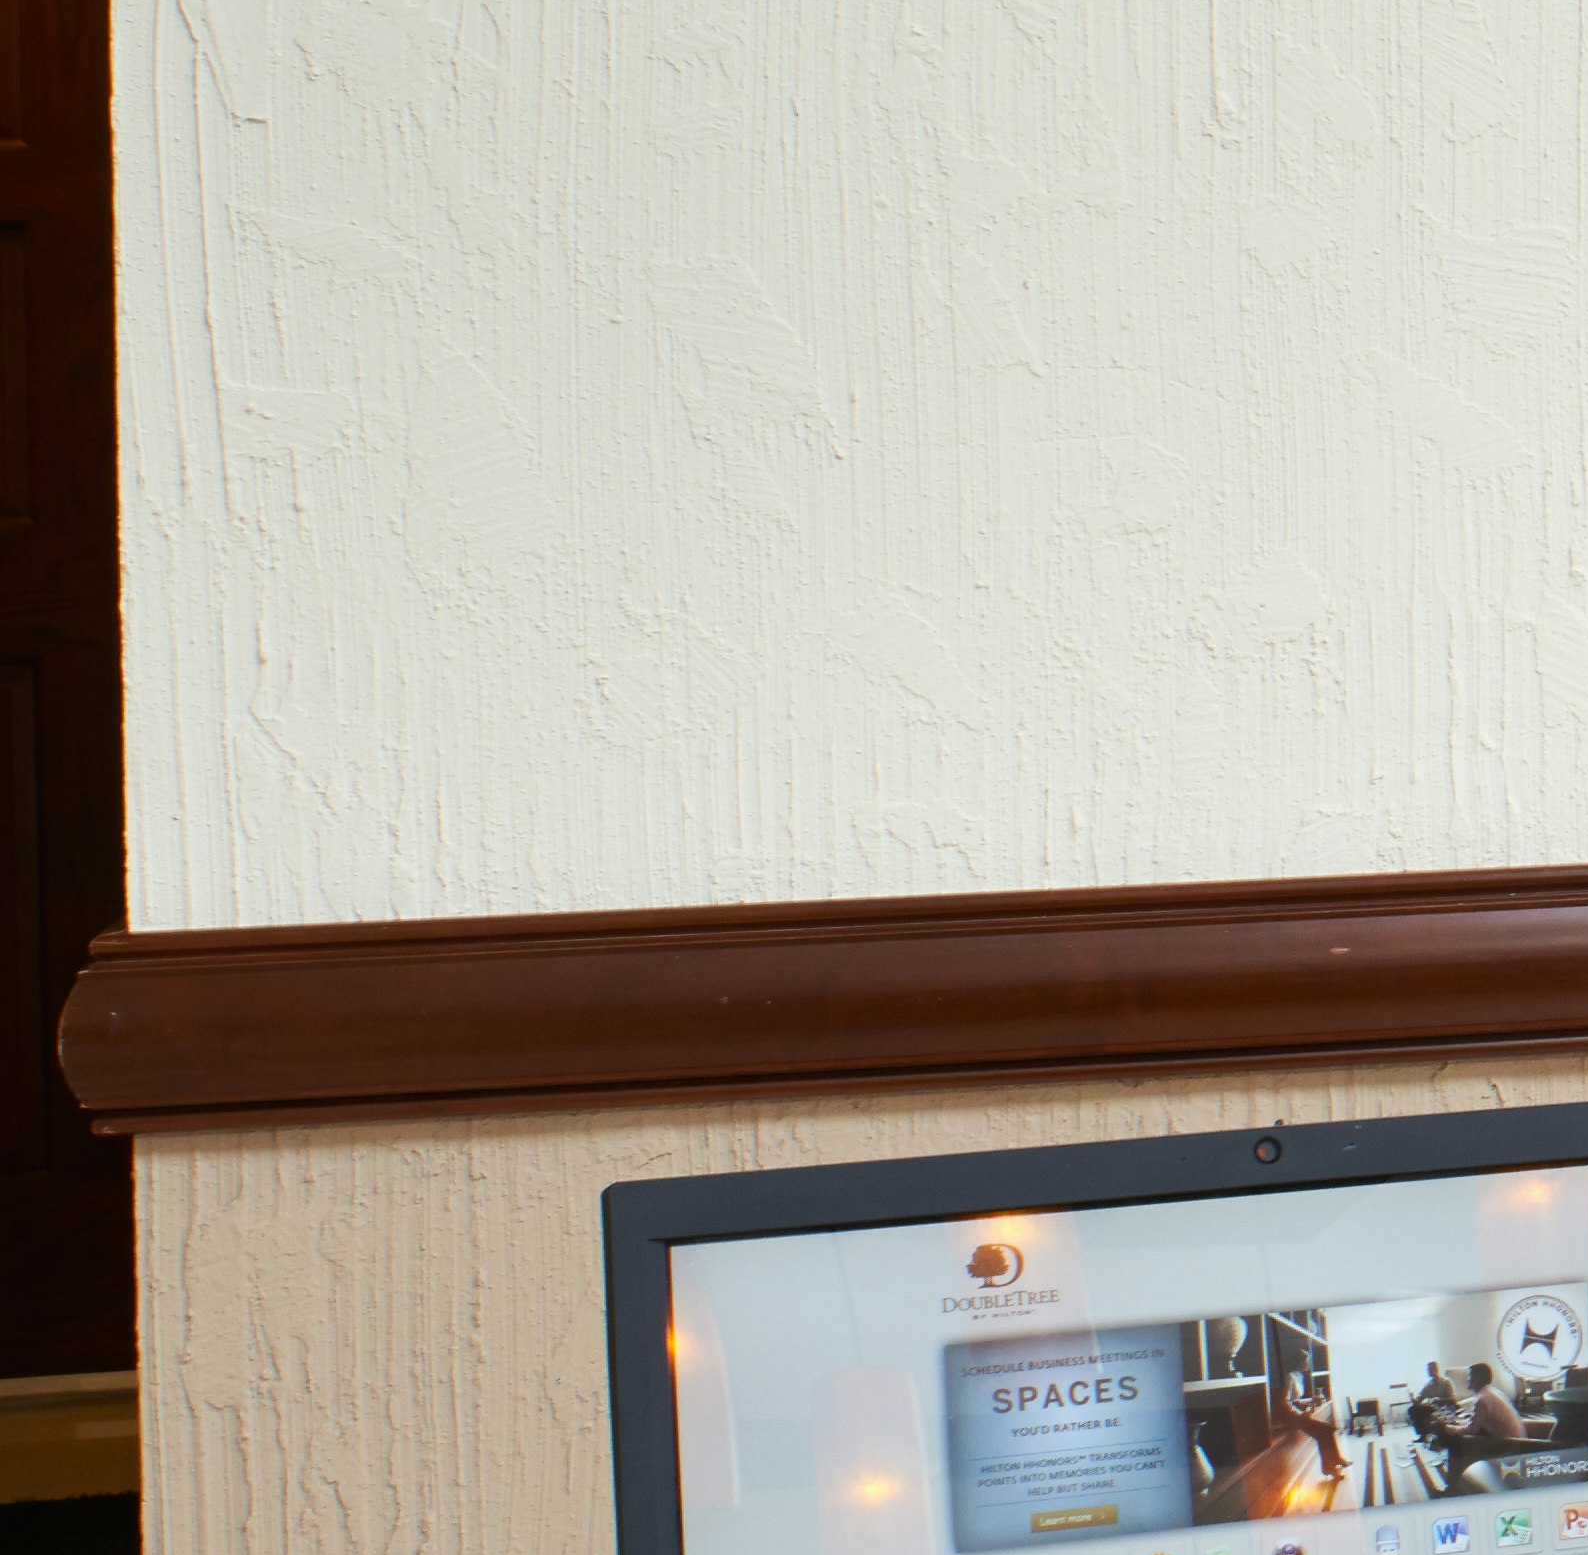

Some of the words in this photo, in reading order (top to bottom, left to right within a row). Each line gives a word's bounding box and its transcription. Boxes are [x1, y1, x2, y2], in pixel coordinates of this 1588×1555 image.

[992, 1375, 1139, 1414] SPACES
[1012, 1423, 1051, 1438] YOU'D
[1054, 1419, 1100, 1433] RATHER
